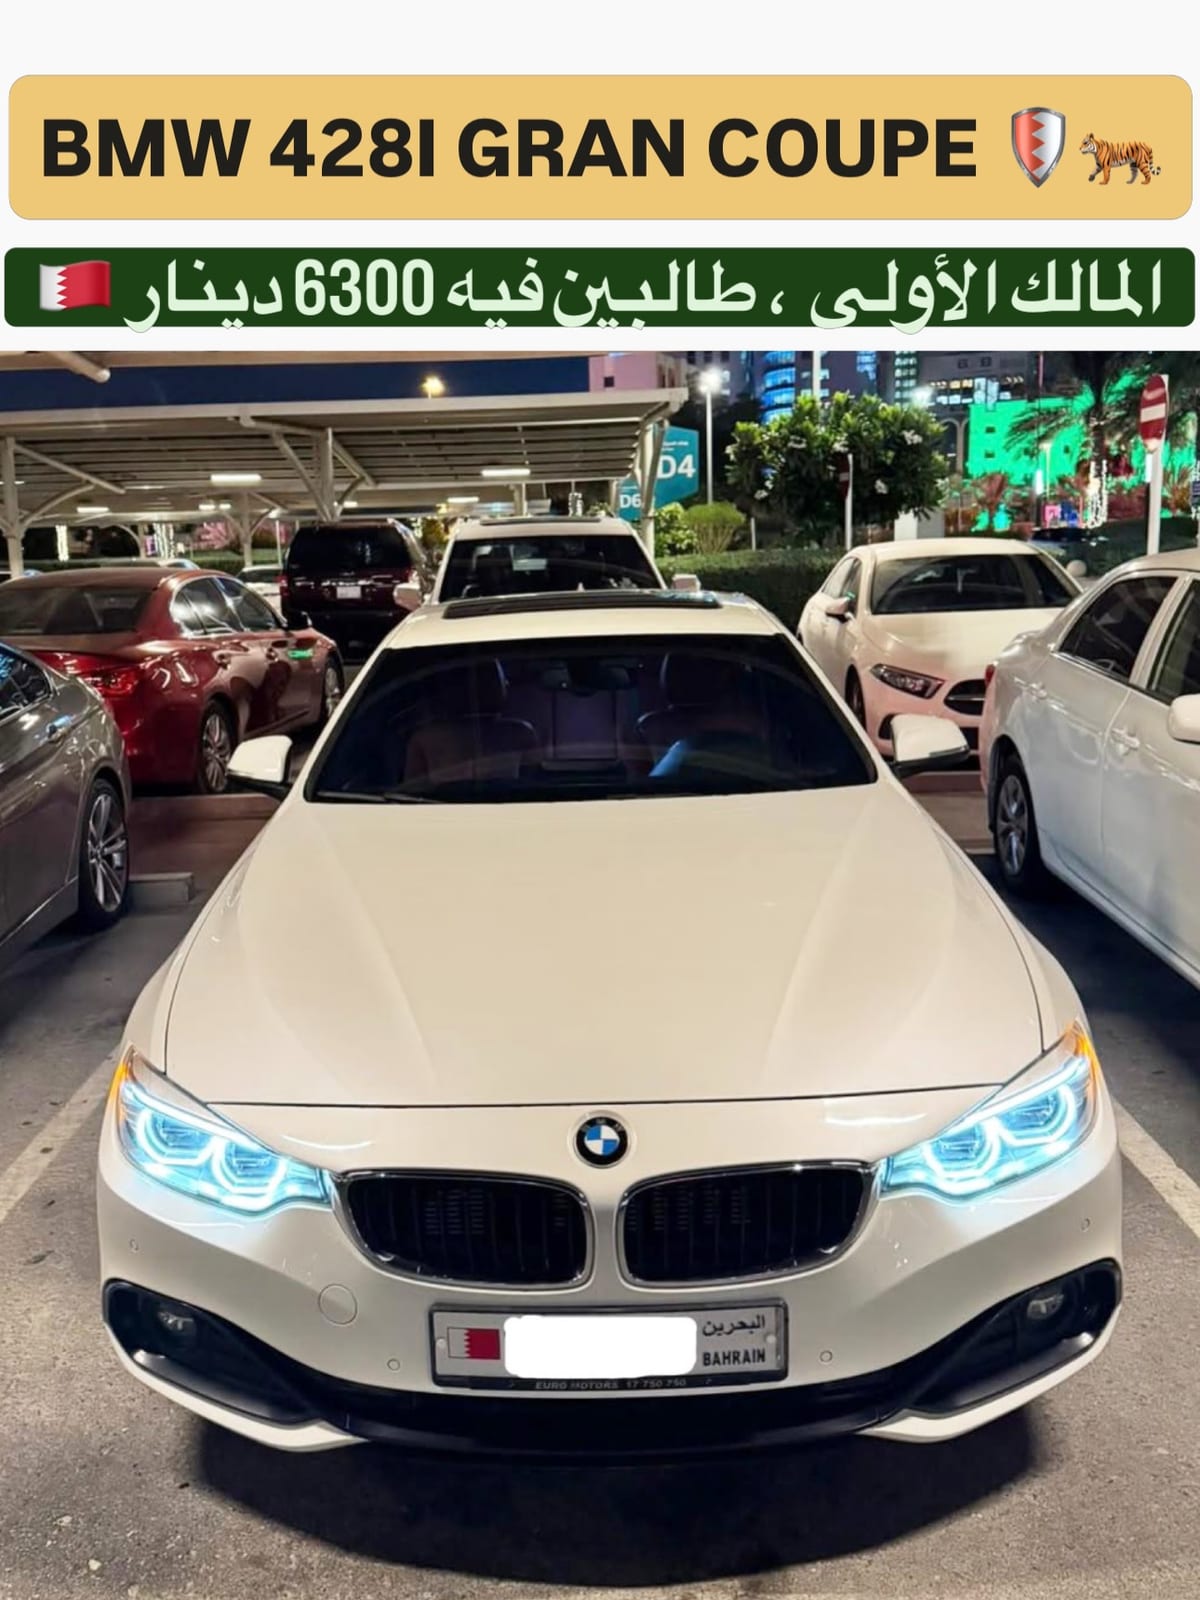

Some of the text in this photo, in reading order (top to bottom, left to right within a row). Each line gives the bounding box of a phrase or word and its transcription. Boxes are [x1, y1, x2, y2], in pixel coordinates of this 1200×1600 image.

[657, 454, 696, 479] D4
[620, 493, 641, 508] D6
[702, 1314, 766, 1336] البحرين
[703, 1347, 766, 1367] BAHRAIN
[535, 1380, 567, 1390] EURO
